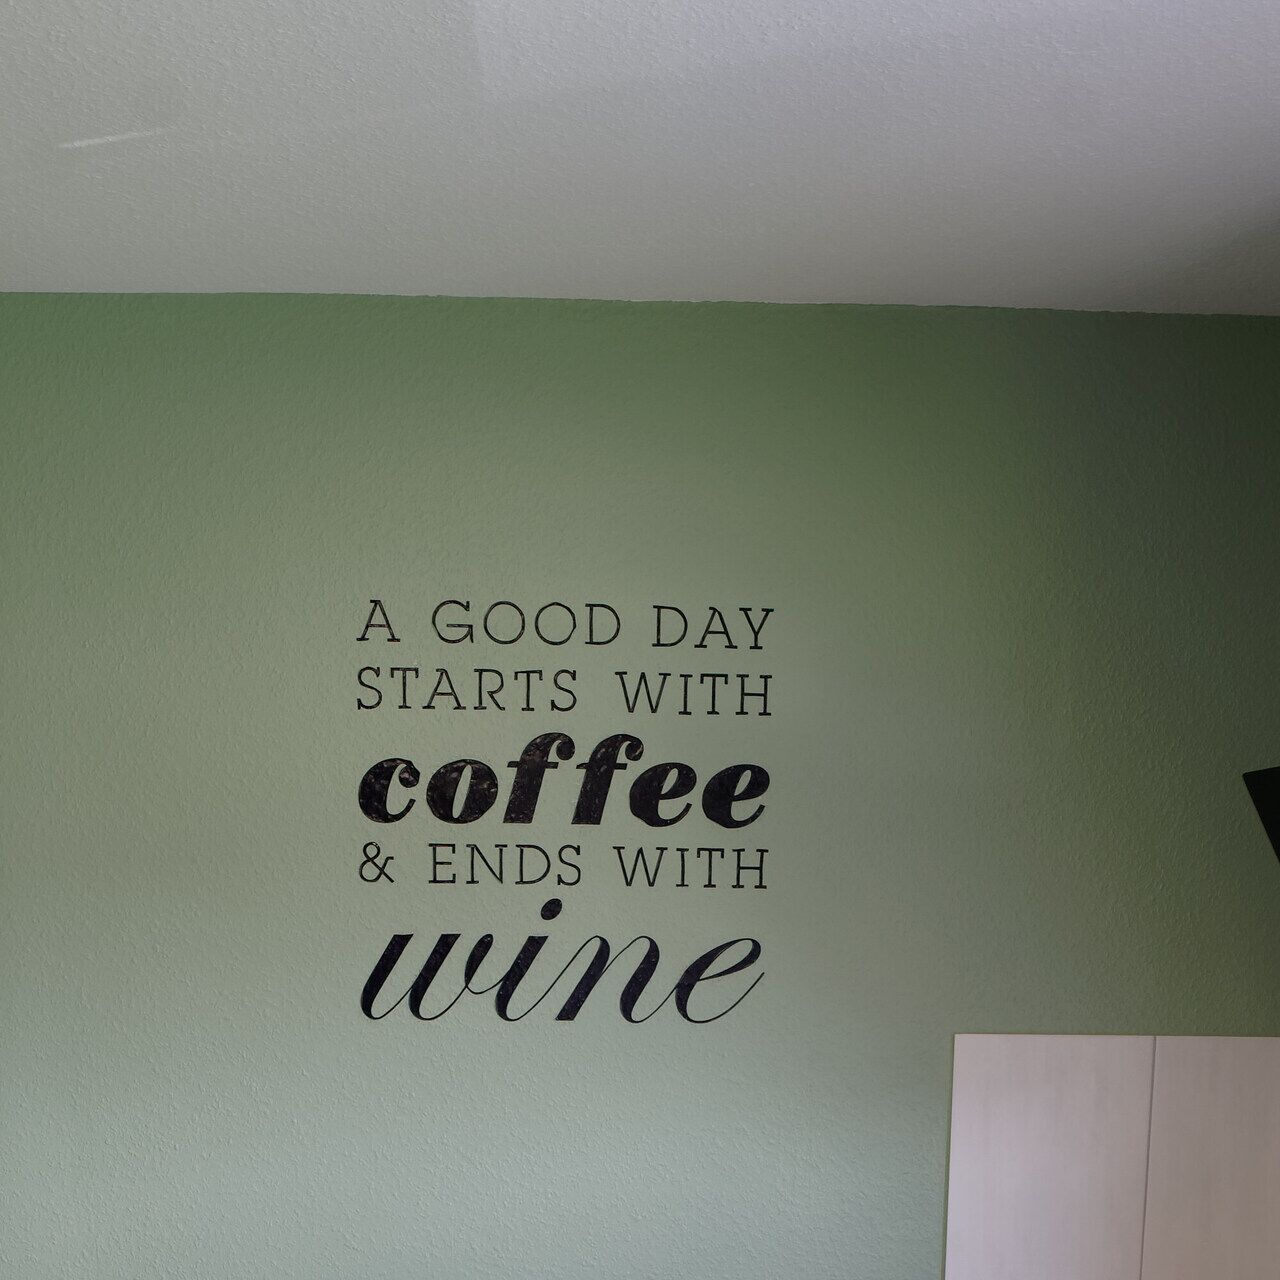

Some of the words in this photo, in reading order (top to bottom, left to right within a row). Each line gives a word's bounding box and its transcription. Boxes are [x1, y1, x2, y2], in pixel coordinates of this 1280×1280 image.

[356, 599, 401, 642] A
[431, 600, 621, 646] GOOD
[652, 605, 774, 650] DAY
[357, 666, 578, 712] STARTS
[615, 671, 772, 716] WITH
[358, 732, 770, 829] coffee
[358, 841, 395, 884] &
[427, 843, 581, 886] ENDS
[612, 846, 769, 889] WITH
[360, 898, 766, 1024] wine
